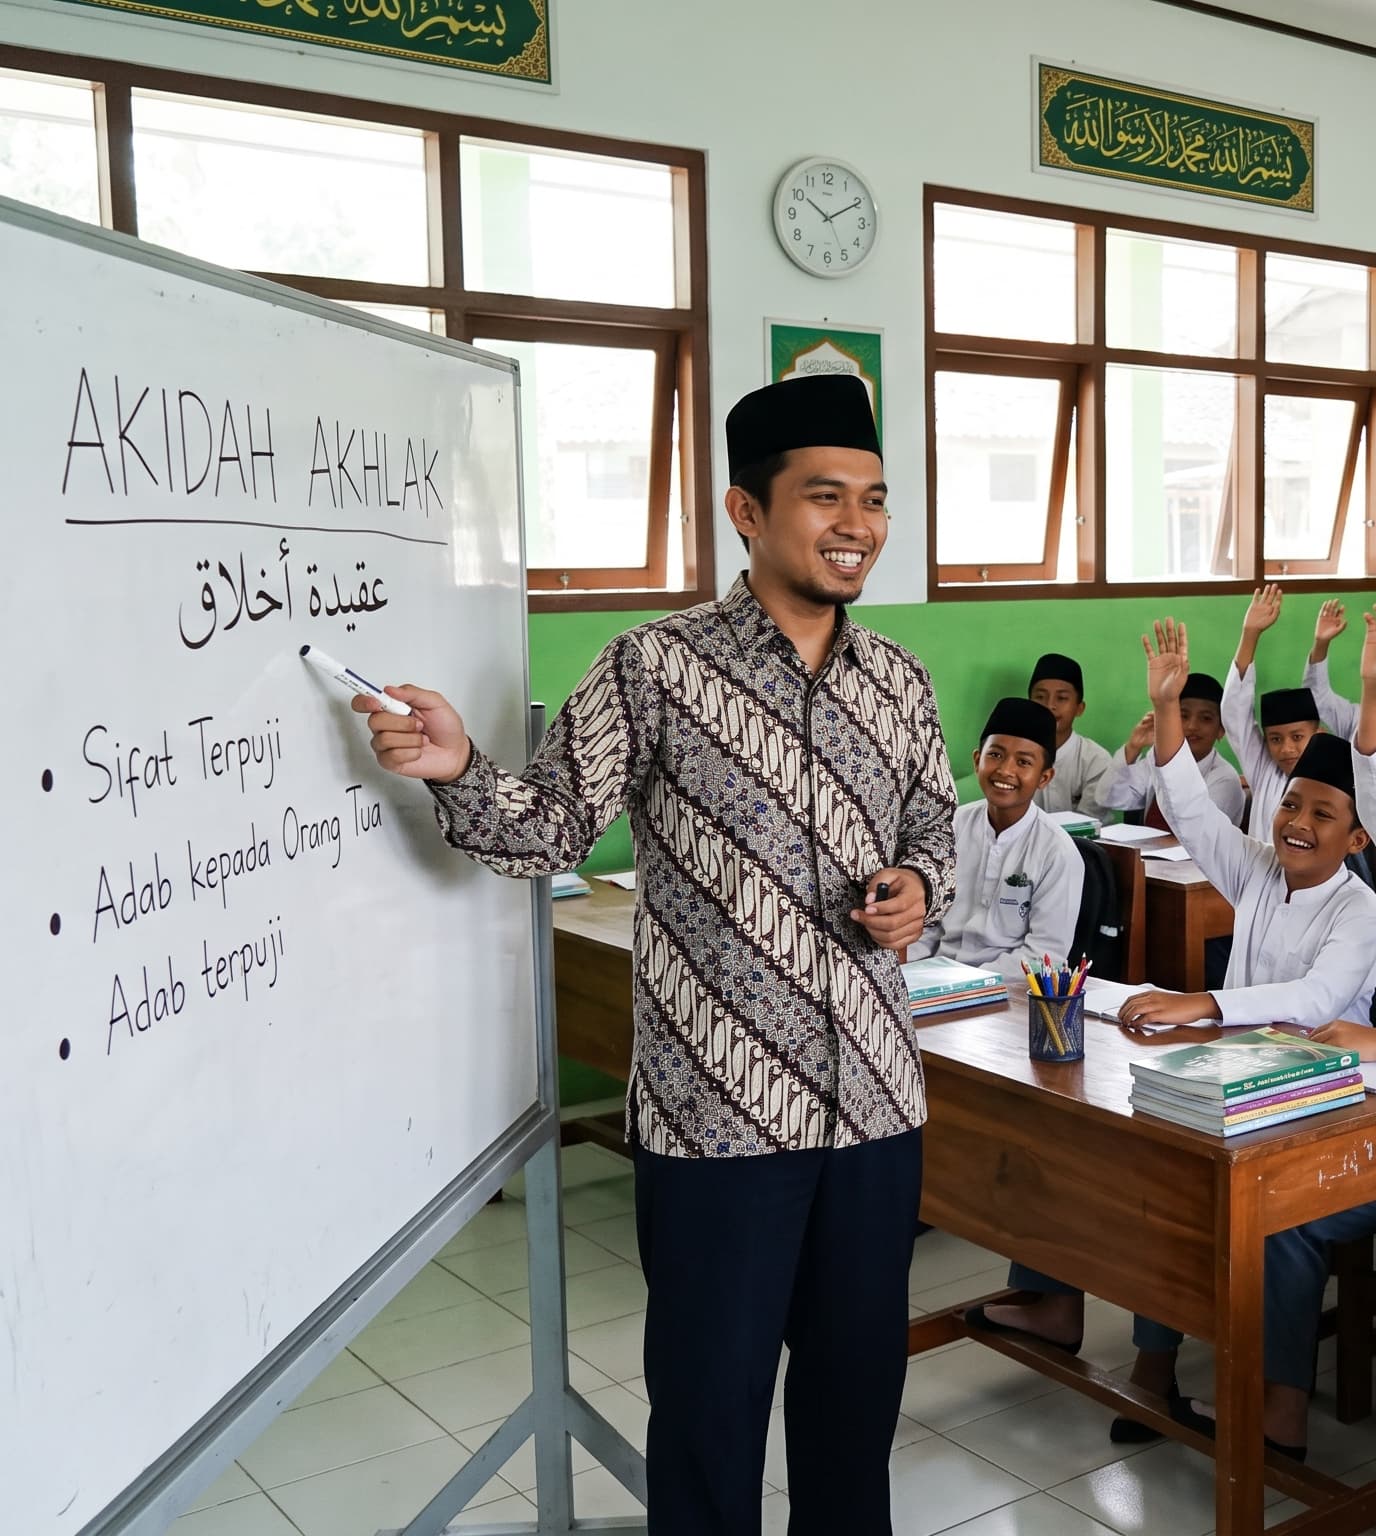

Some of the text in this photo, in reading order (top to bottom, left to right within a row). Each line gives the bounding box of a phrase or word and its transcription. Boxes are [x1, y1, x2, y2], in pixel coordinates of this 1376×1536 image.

[805, 175, 815, 188] 11
[822, 172, 834, 186] 12
[843, 180, 848, 192] 1
[792, 188, 805, 201] 10
[853, 197, 862, 209] 2
[787, 207, 797, 220] 9
[857, 217, 866, 230] 3
[793, 228, 802, 241] 8
[852, 237, 860, 248] 4
[807, 244, 815, 257] 7
[840, 249, 849, 261] 5
[823, 251, 832, 264] 6
[62, 367, 443, 518] AKIDAH AKHLAK
[179, 537, 389, 650] عقيدة أخلاق
[83, 716, 282, 818] Sifat Terpuji
[93, 784, 383, 943] Adab kepada Orang Tua
[107, 915, 284, 1056] Adab terpuji
